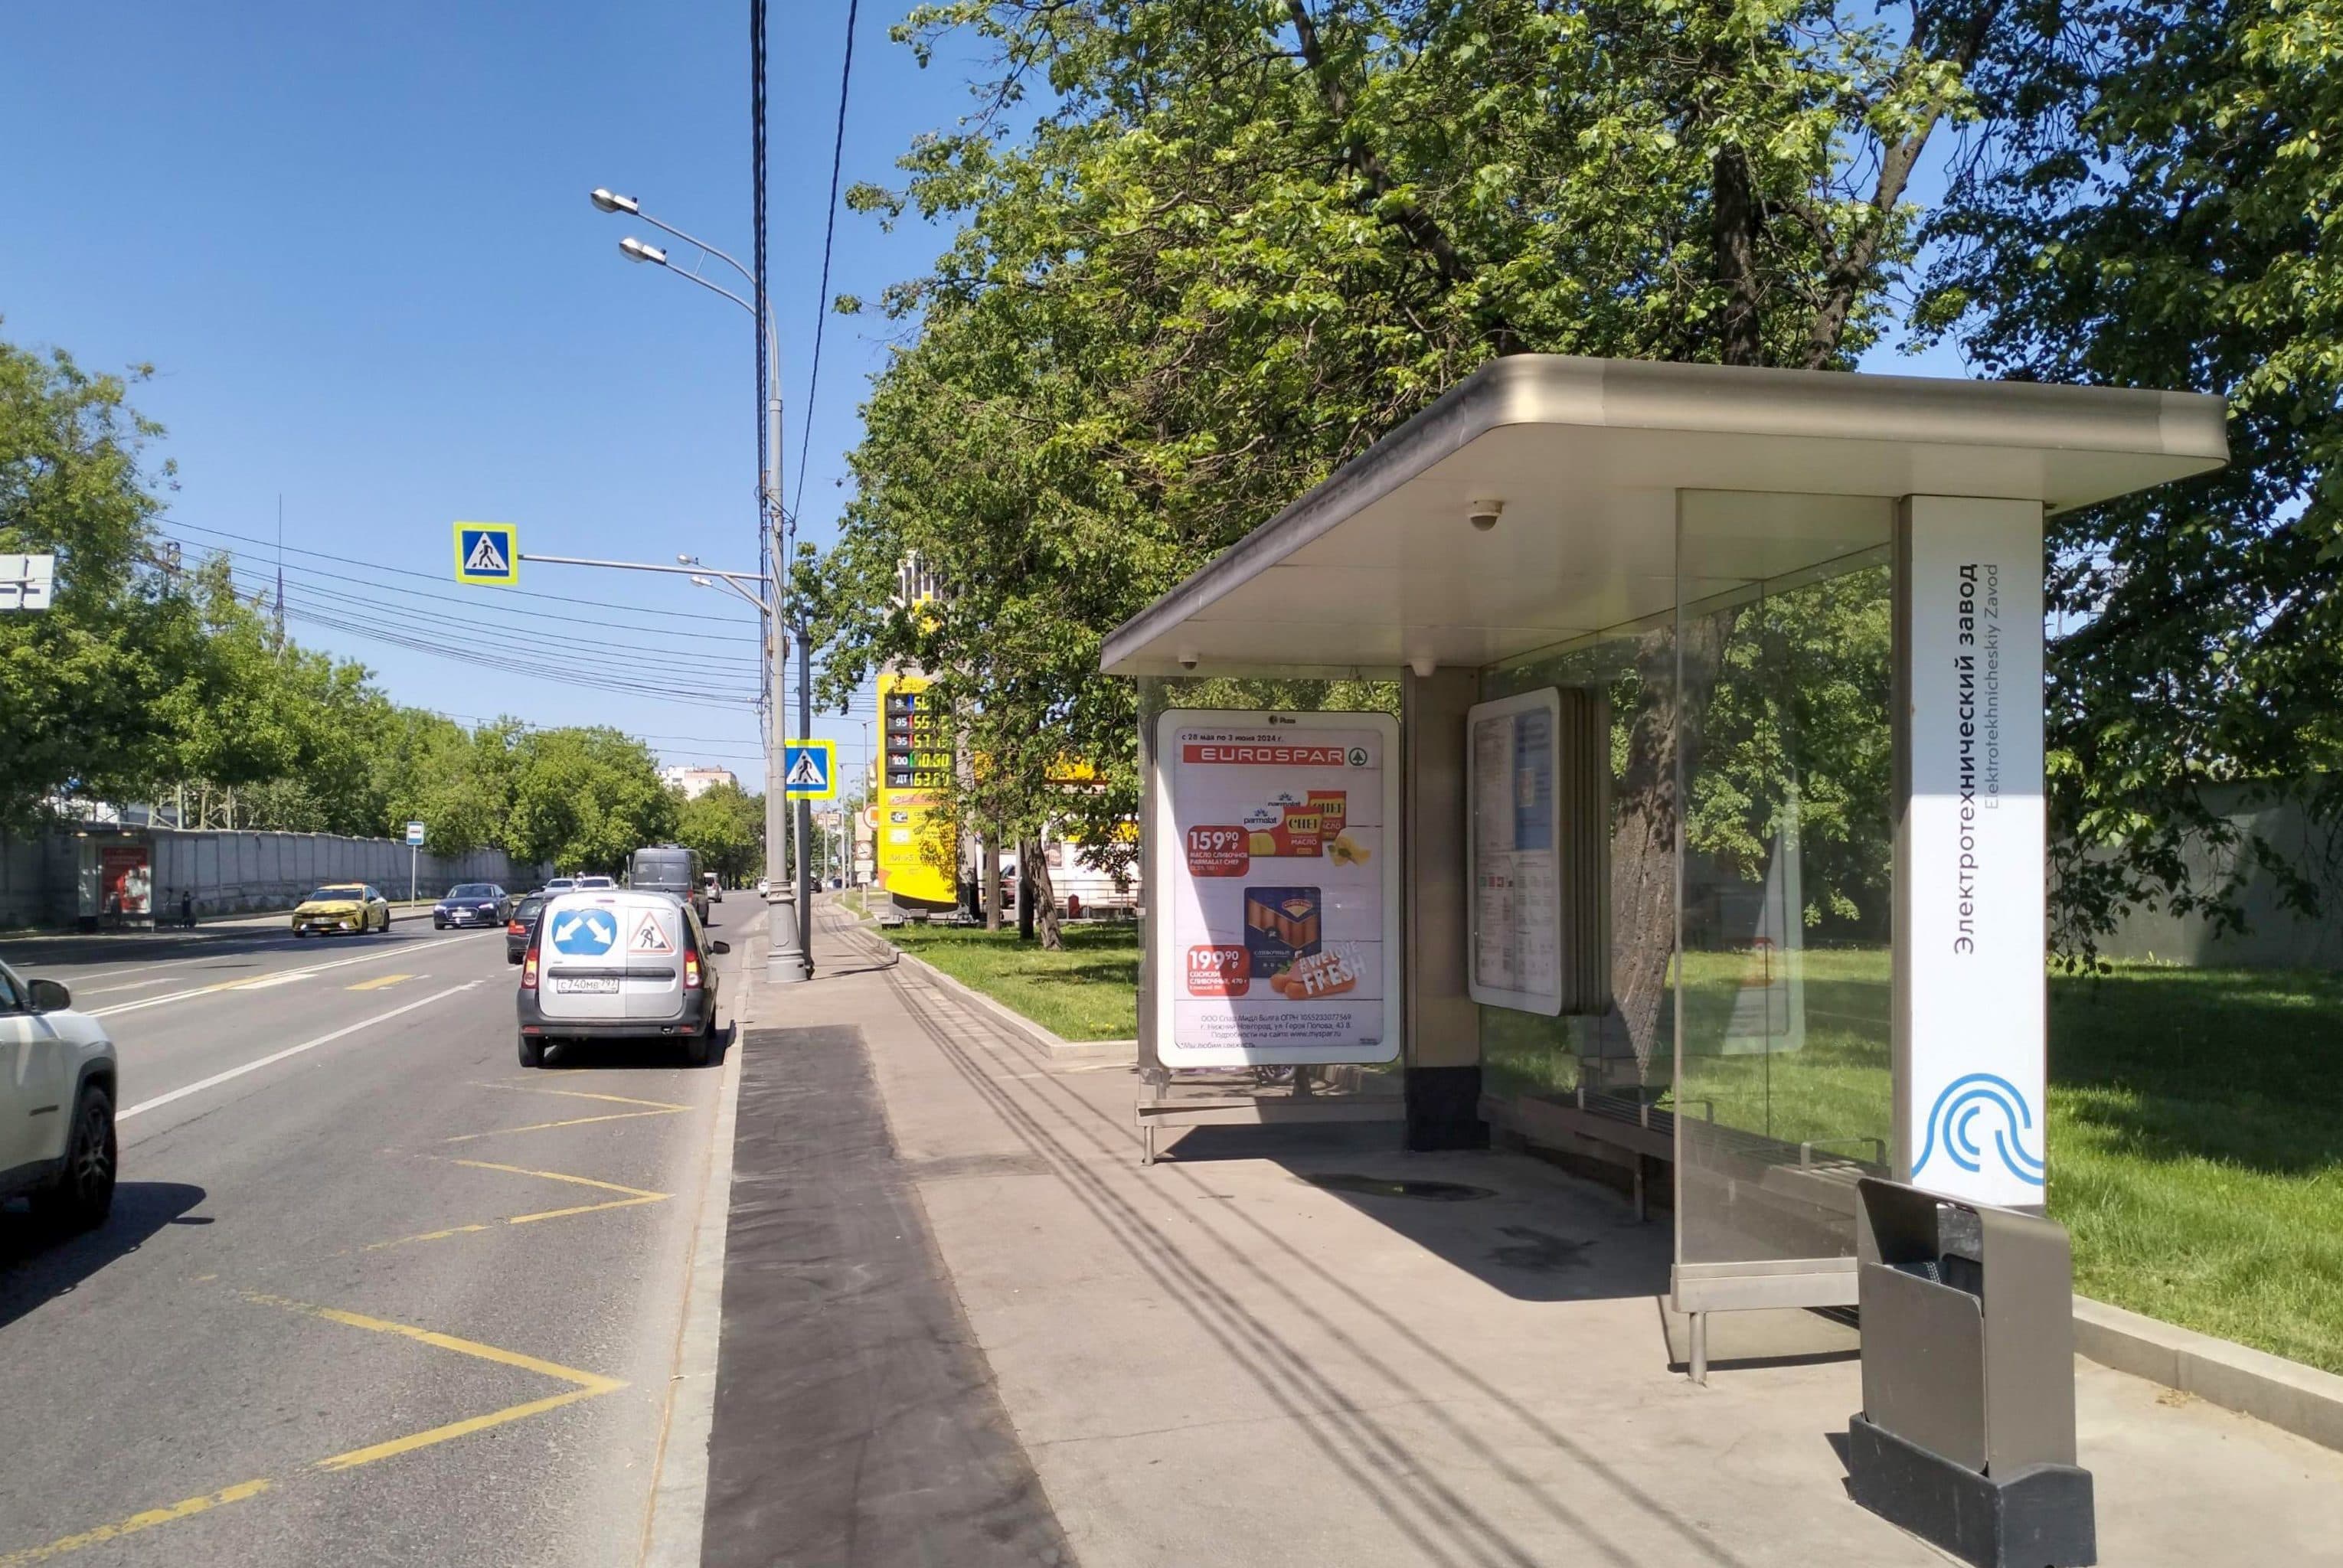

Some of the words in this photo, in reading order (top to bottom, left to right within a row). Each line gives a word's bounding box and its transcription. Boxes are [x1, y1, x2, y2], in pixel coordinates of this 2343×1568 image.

[1984, 564, 1998, 619] Zavod
[1959, 564, 1978, 645] завод
[895, 717, 907, 727] 95
[1984, 624, 2001, 808] Elektrotekhnicheskiy
[896, 737, 907, 746] 95
[894, 756, 908, 766] 100
[1201, 747, 1343, 763] EUROSPAR
[896, 774, 908, 784] ДТ
[1954, 655, 1979, 955] Электротехнический
[1243, 816, 1277, 825] parmalat
[1189, 831, 1225, 851] 159
[1189, 950, 1225, 970] 199
[1302, 955, 1367, 995] FRESH
